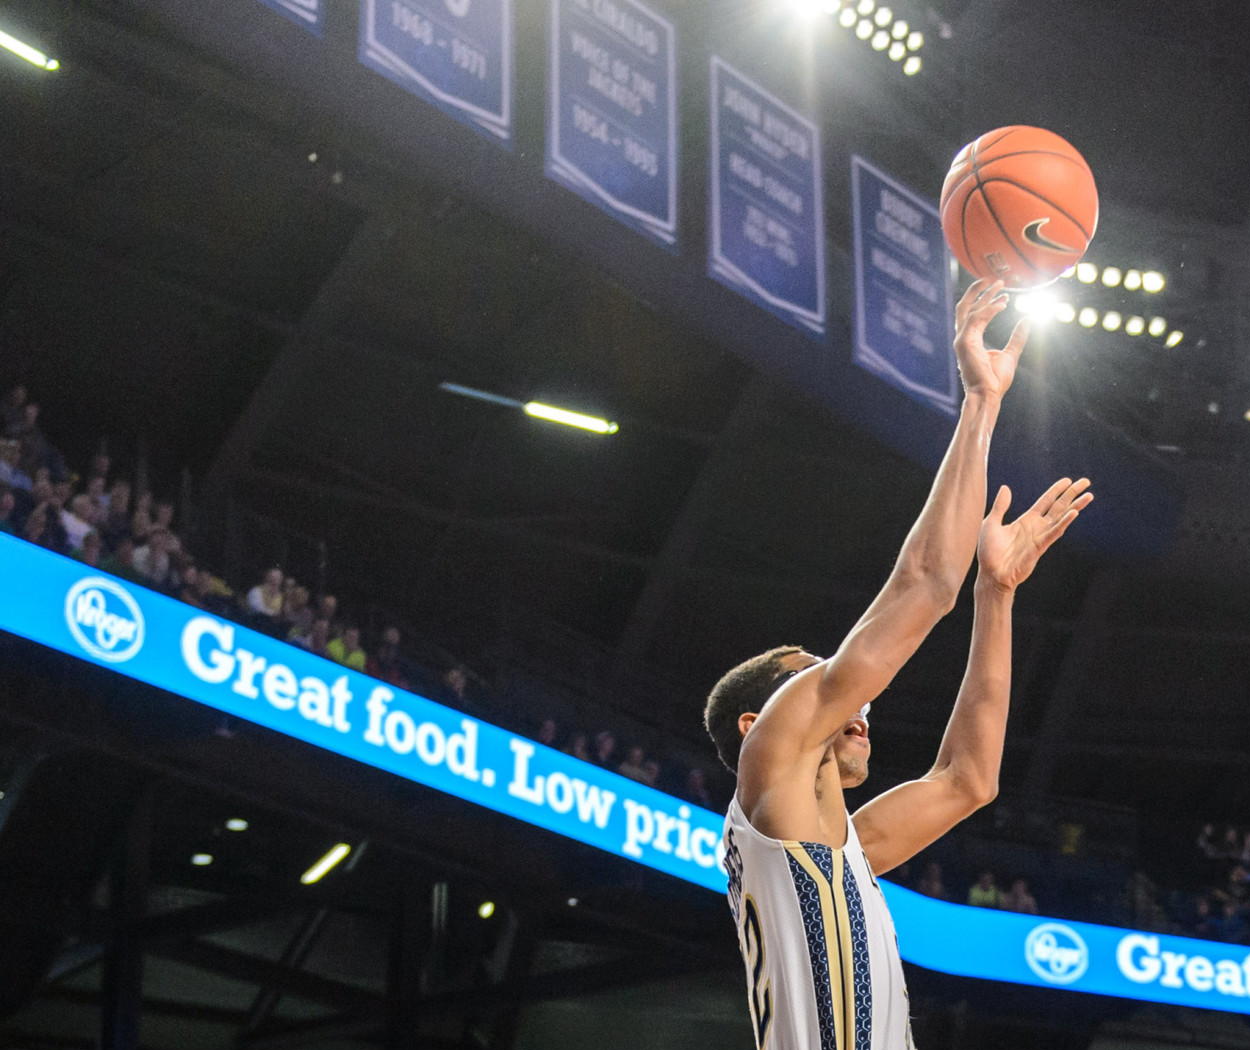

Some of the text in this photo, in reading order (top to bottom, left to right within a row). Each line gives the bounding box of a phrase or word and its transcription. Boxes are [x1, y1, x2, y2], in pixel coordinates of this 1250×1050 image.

[181, 616, 353, 734] Great
[364, 686, 496, 787] food.
[508, 737, 617, 830] Low
